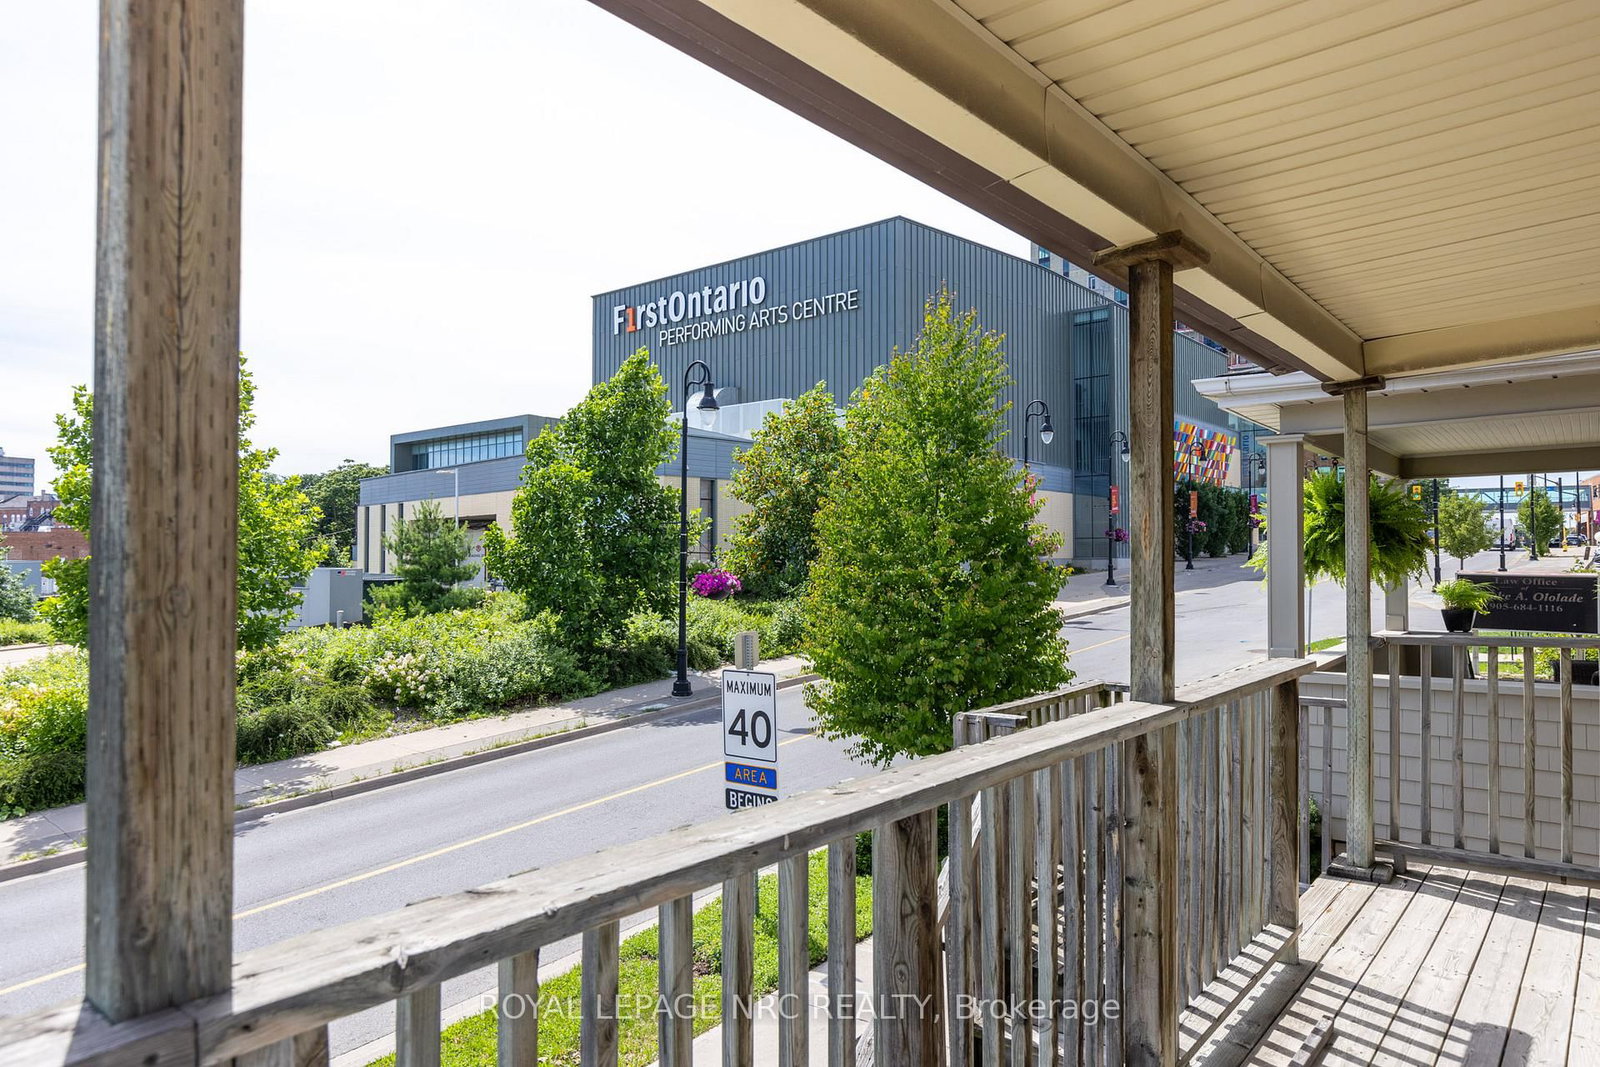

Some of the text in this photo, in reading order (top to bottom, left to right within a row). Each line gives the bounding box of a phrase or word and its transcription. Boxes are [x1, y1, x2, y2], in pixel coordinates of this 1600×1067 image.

[659, 289, 859, 347] PERFORMING ARTS CENTRE
[1494, 577, 1558, 586] Law Office
[1532, 592, 1584, 603] Ololade
[726, 679, 772, 697] MAXIMUM
[728, 708, 771, 748] 40
[734, 767, 768, 785] AREA
